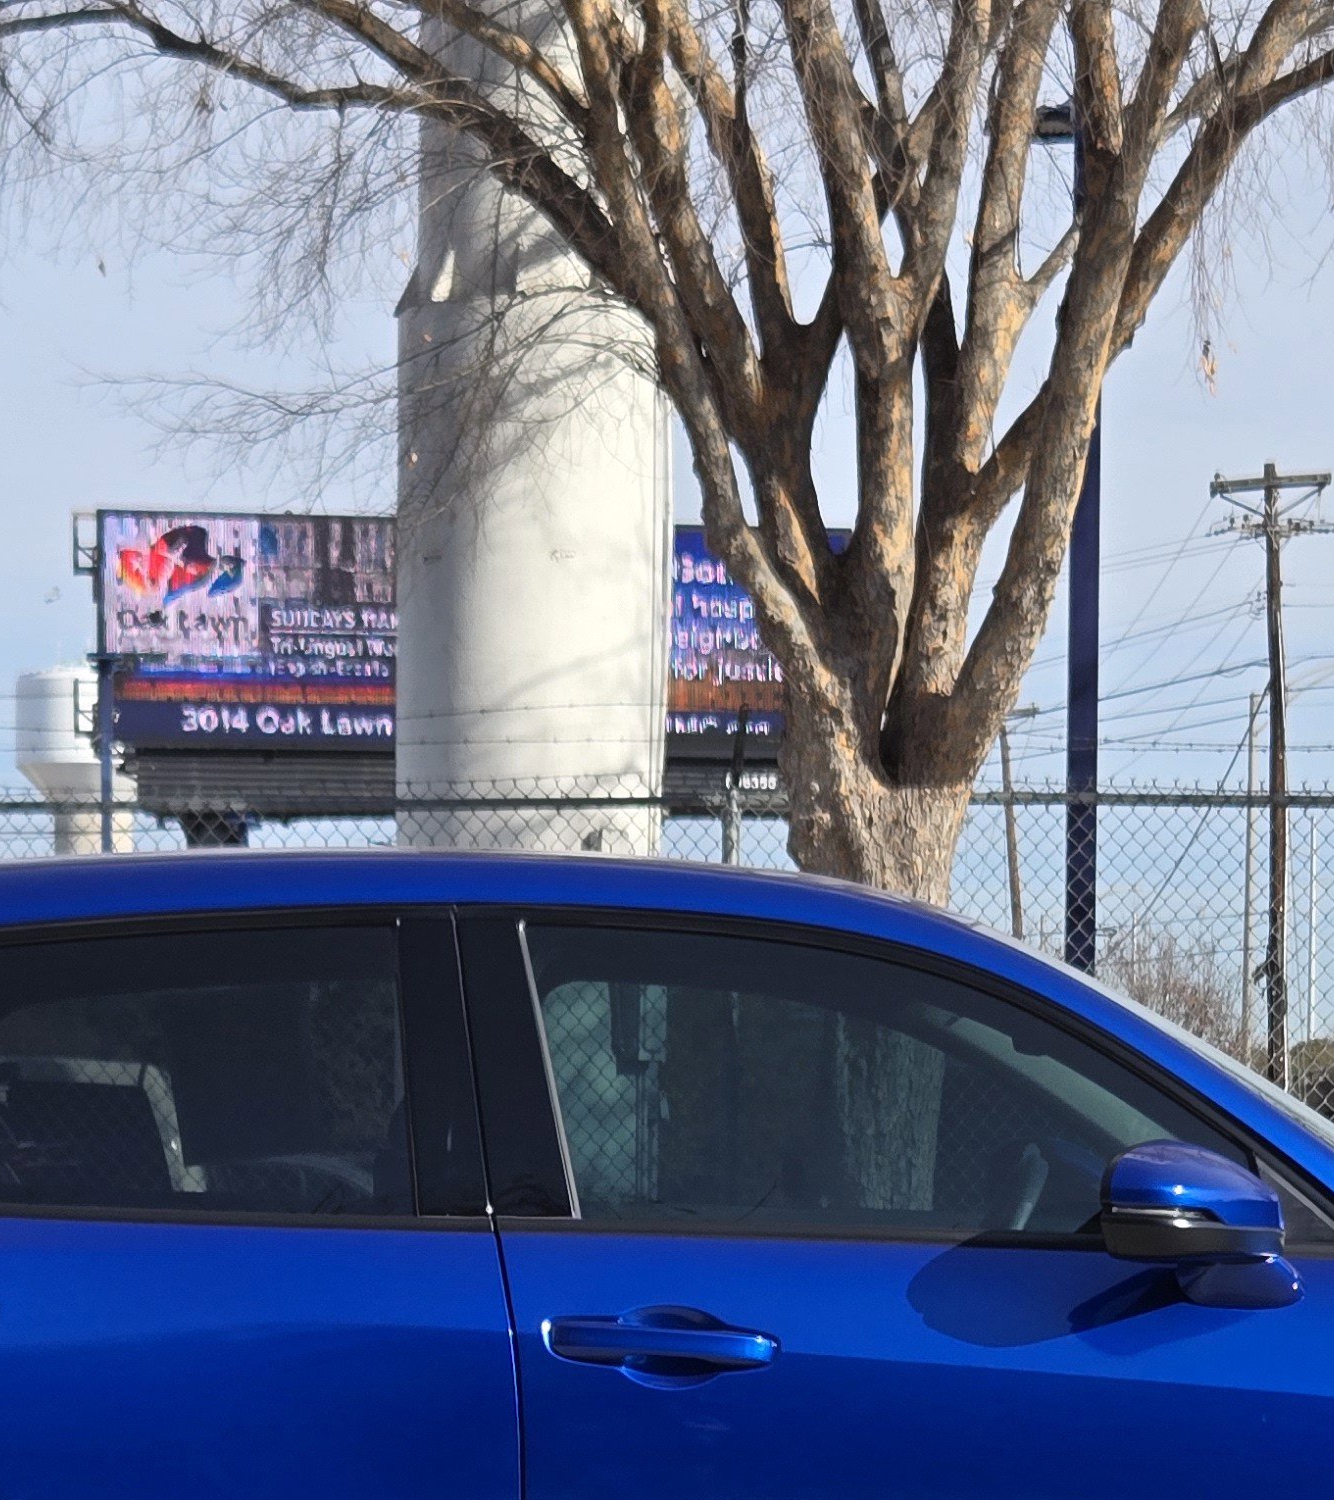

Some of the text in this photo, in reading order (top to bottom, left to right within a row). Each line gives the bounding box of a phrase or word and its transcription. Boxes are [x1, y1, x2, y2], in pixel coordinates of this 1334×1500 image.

[180, 705, 394, 737] 3014 Oak Lawn
